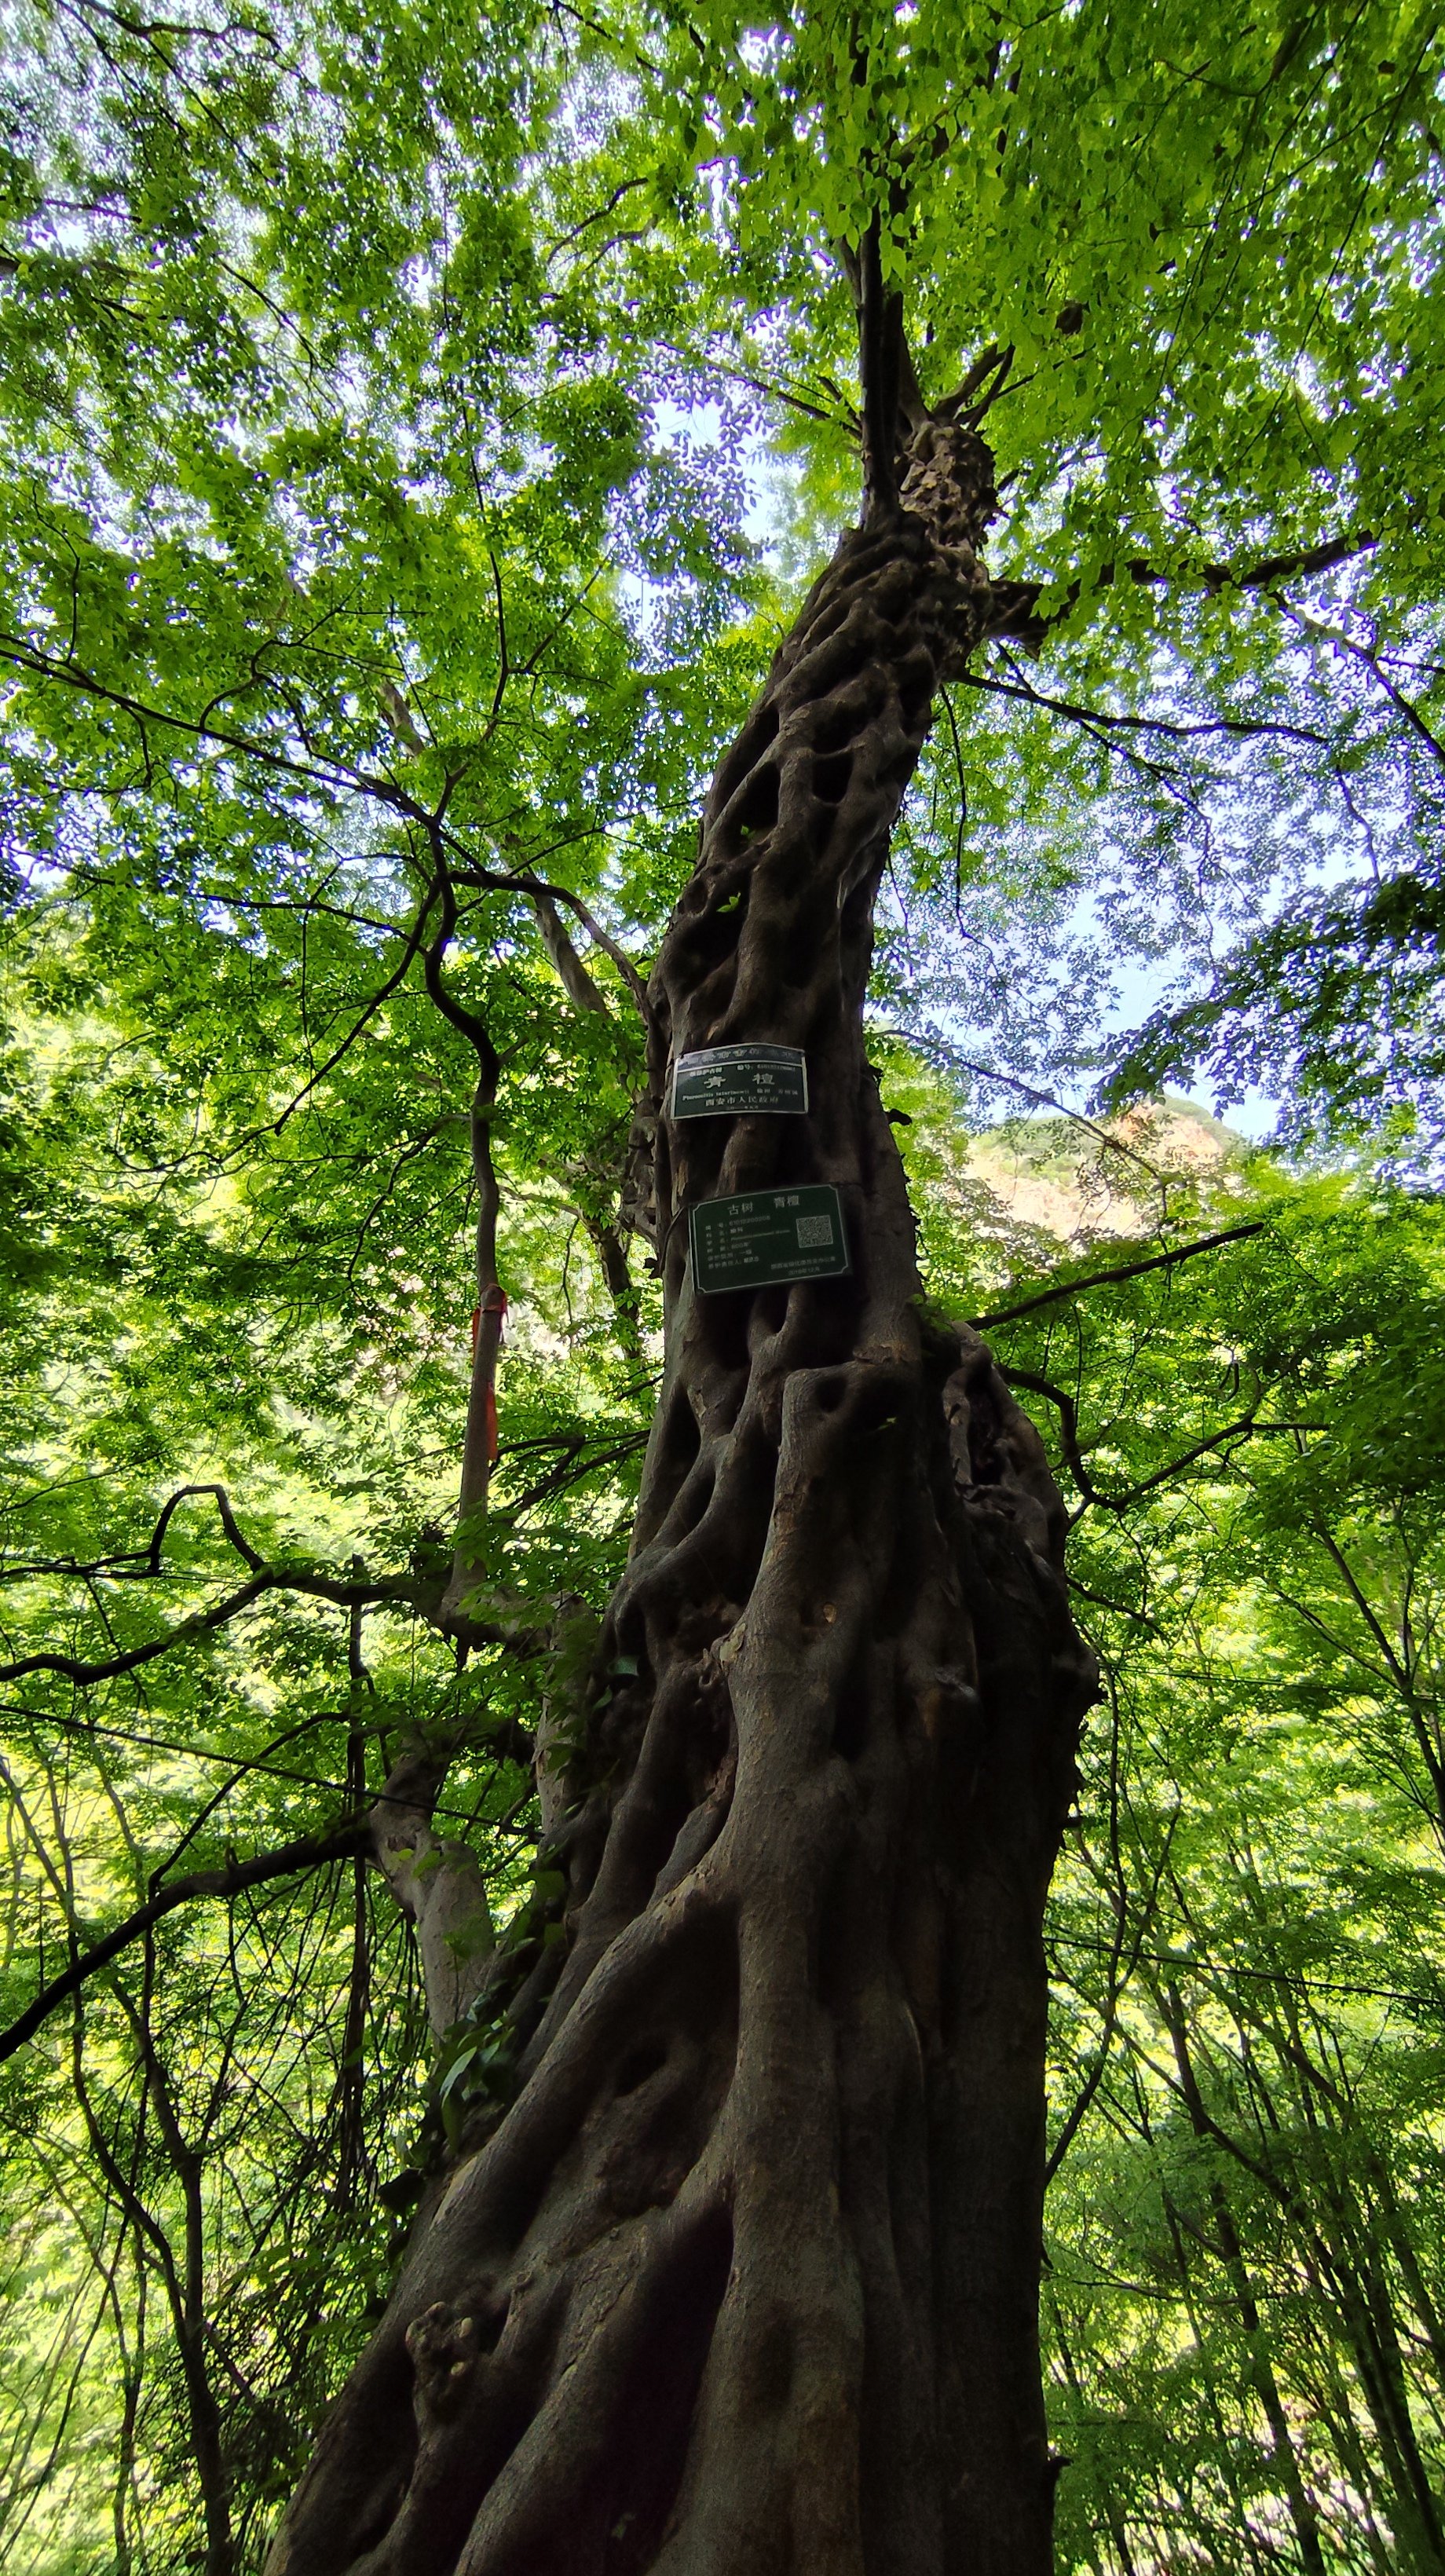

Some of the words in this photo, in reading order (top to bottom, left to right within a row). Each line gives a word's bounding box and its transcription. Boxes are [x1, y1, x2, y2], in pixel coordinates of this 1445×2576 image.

[705, 1095, 779, 1107] 西安市人民政府
[727, 1202, 753, 1216] 古树
[773, 1195, 799, 1209] 青檀
